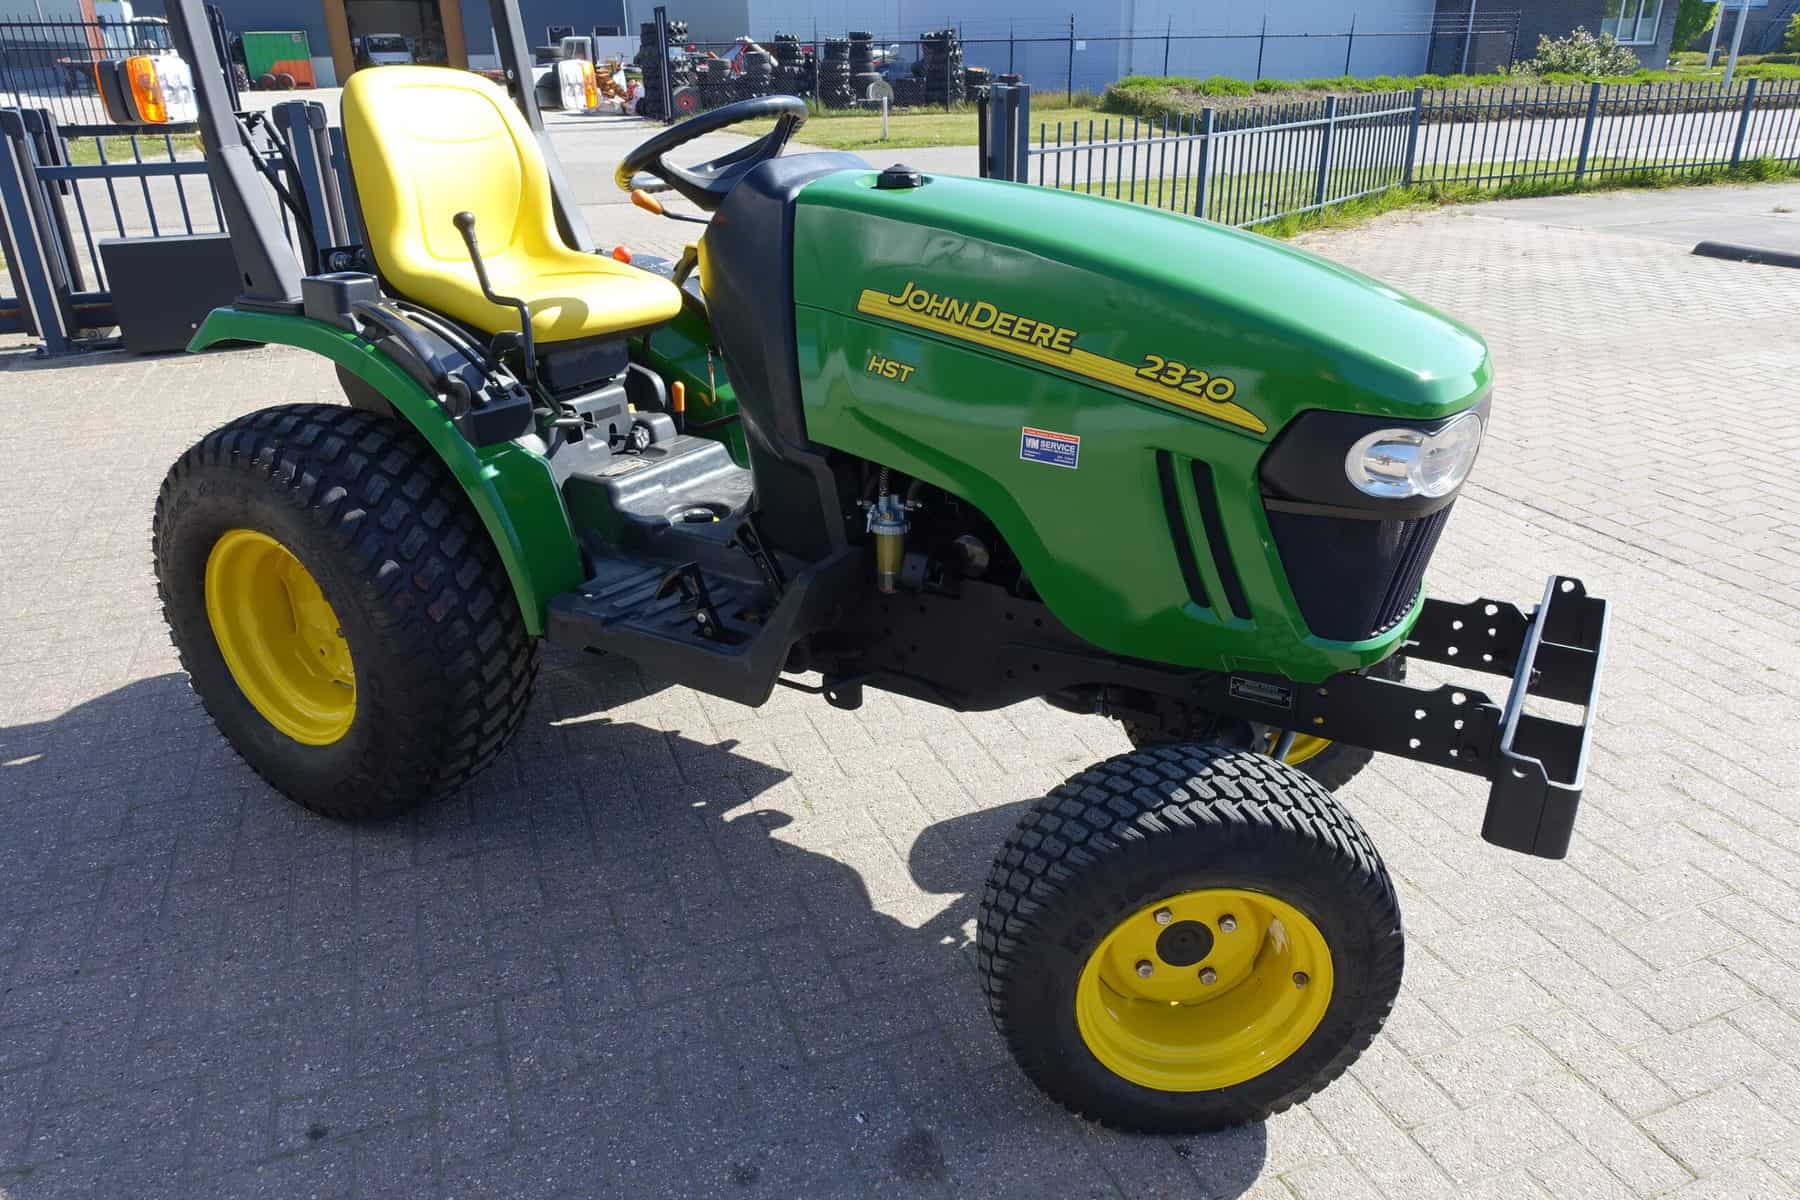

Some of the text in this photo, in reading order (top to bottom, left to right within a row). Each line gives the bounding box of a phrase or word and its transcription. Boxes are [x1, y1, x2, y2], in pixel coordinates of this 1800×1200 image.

[888, 281, 1078, 353] JOHN DEERE
[867, 355, 915, 383] HST
[1136, 354, 1236, 403] 2320
[1040, 440, 1076, 453] SERVICE
